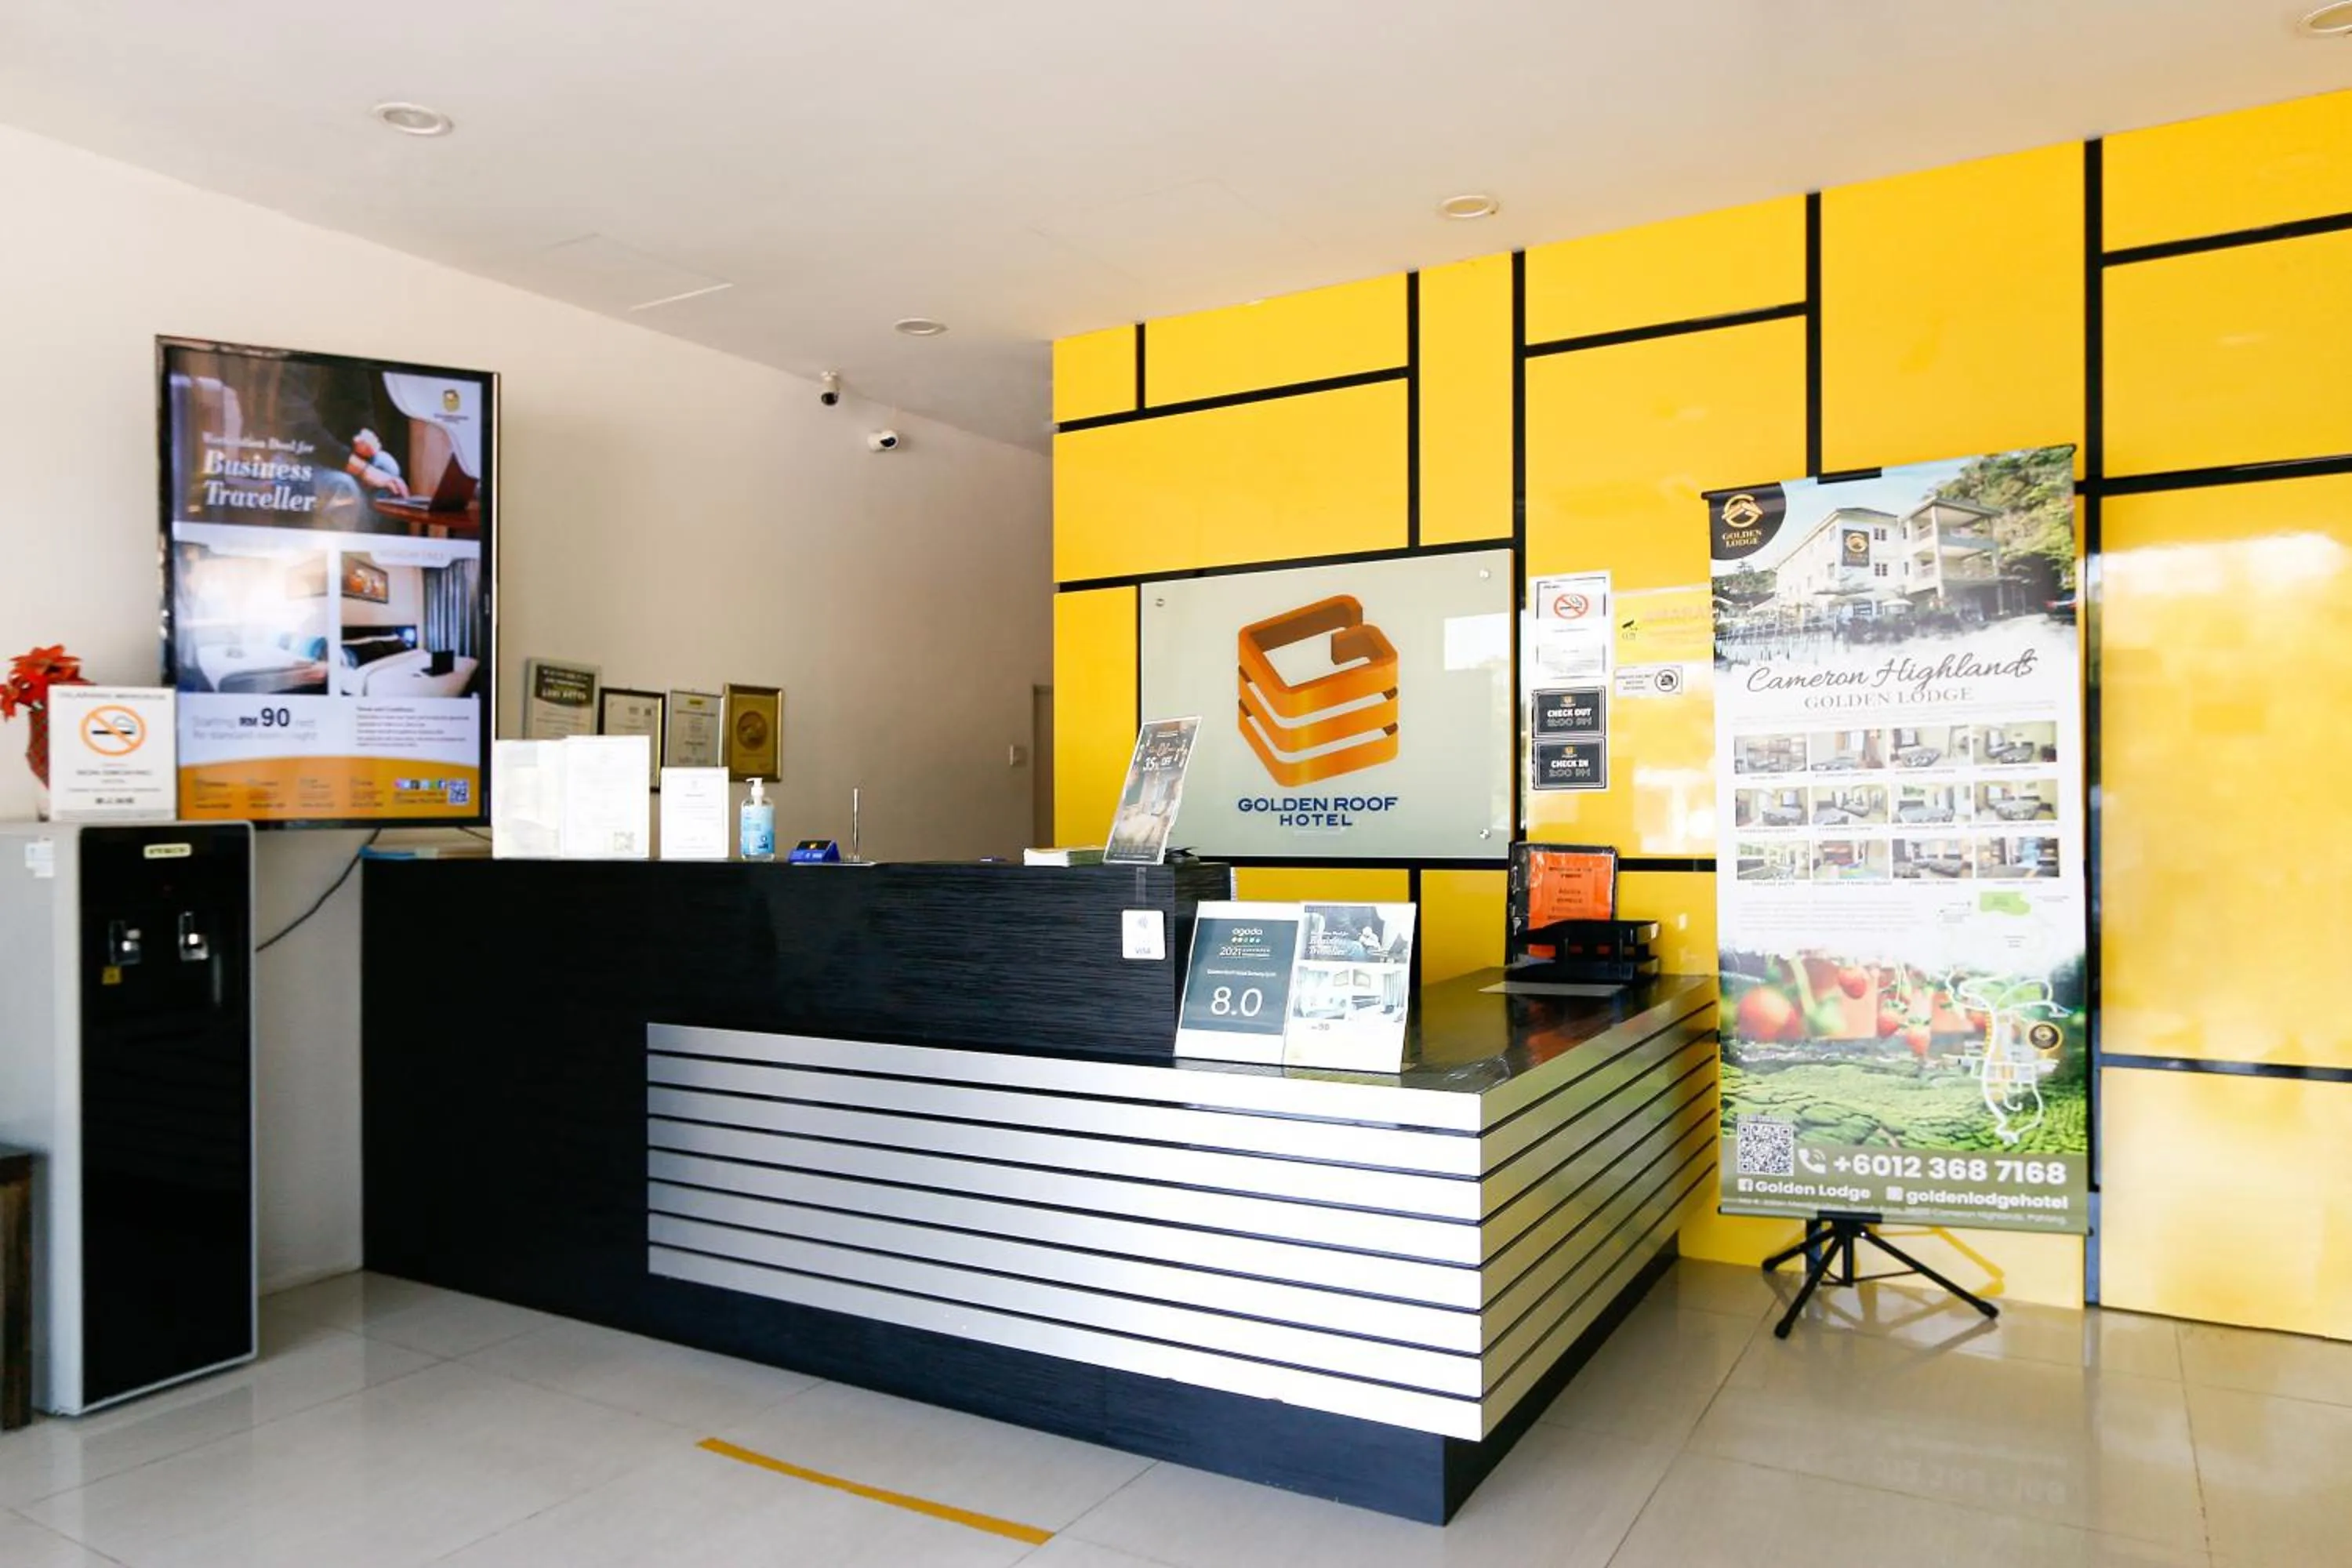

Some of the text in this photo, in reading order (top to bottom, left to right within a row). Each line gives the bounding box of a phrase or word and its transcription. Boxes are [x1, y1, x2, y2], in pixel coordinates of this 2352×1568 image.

[202, 449, 313, 481] Business
[204, 479, 317, 511] Traveller
[1747, 648, 2038, 693] Cameron Highlands
[1804, 687, 1974, 710] GOLDEN LODGE
[261, 707, 291, 727] 90
[1547, 707, 1592, 717] CHECK OUT
[1551, 759, 1589, 768] CHECK IN
[1238, 797, 1398, 811] GOLDEN ROOF
[1279, 814, 1352, 826] HOTEL
[1232, 928, 1263, 937] agoda
[1219, 946, 1242, 956] 2021
[1211, 986, 1262, 1017] 8.0
[1833, 1153, 2067, 1185] +6012 368 7168
[1755, 1181, 1871, 1201] Golden Lodge
[1906, 1190, 2069, 1209] goldenlodgehotel
